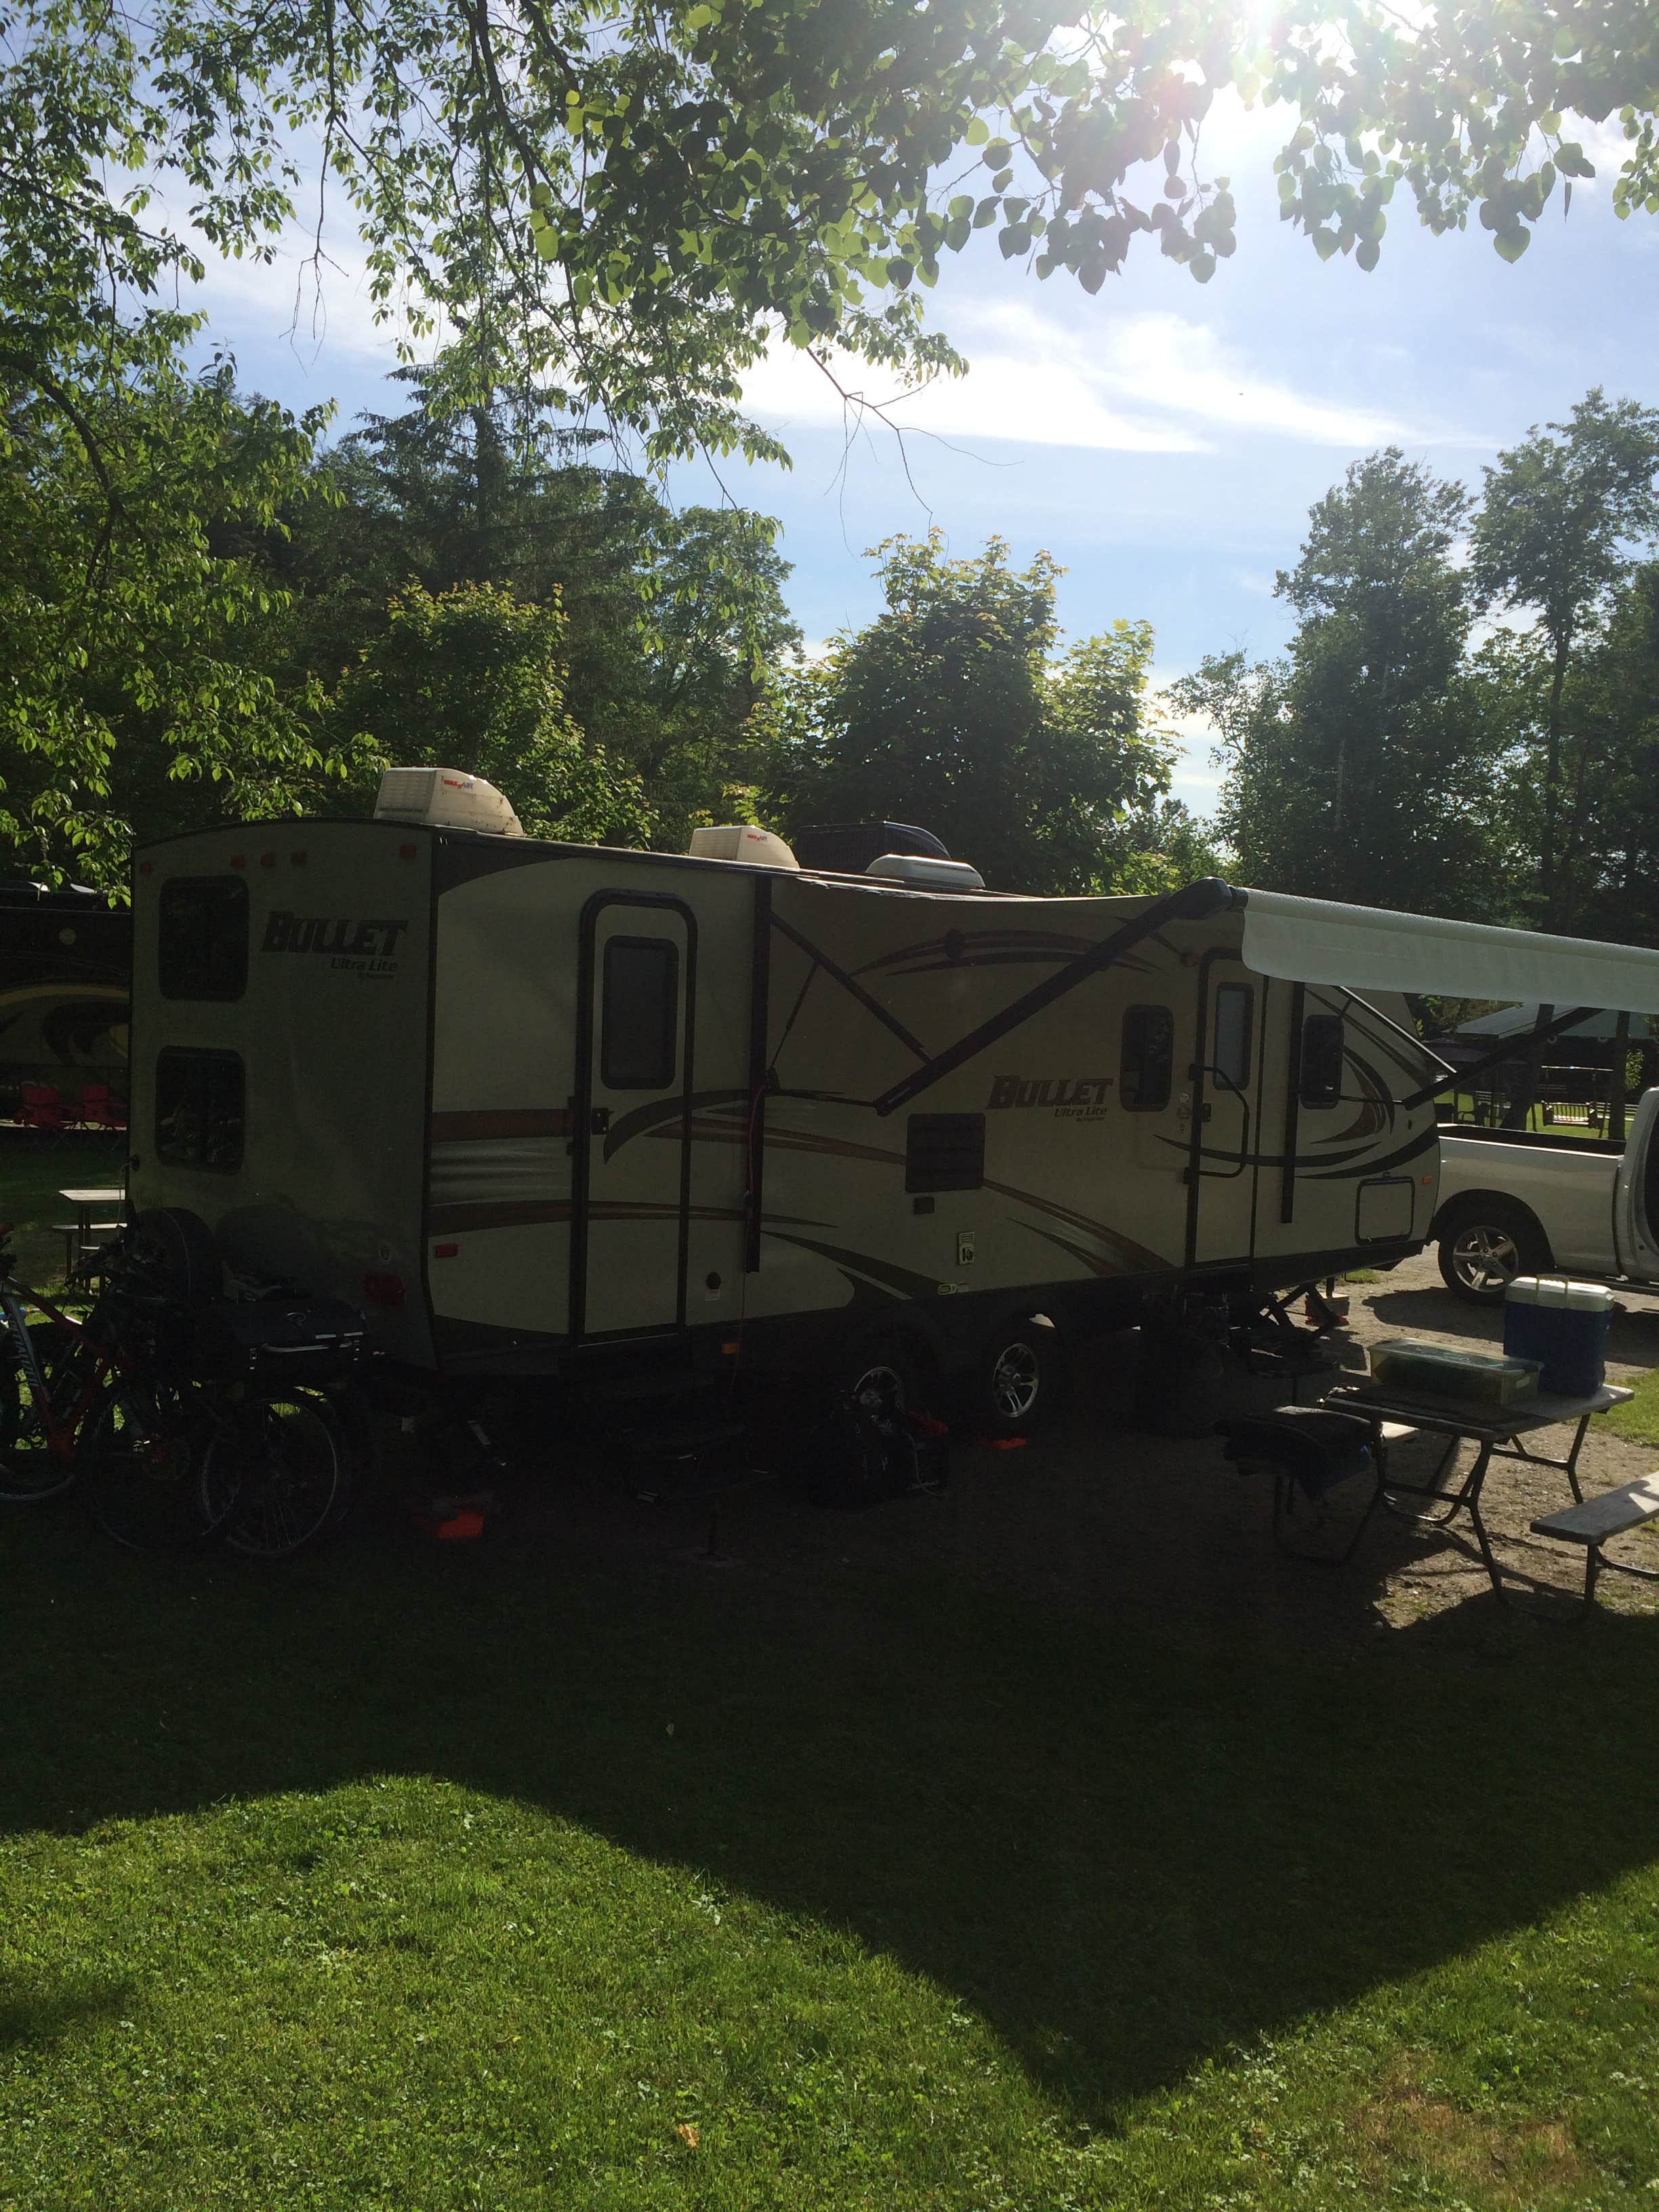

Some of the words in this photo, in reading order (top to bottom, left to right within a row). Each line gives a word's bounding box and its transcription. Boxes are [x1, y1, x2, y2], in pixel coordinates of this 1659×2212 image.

[260, 911, 409, 956] BULLET
[330, 958, 366, 970] Ultra
[369, 959, 398, 972] Lite
[985, 1076, 1115, 1109] BULLET
[1054, 1107, 1084, 1118] Ultra
[1086, 1106, 1107, 1116] Lite
